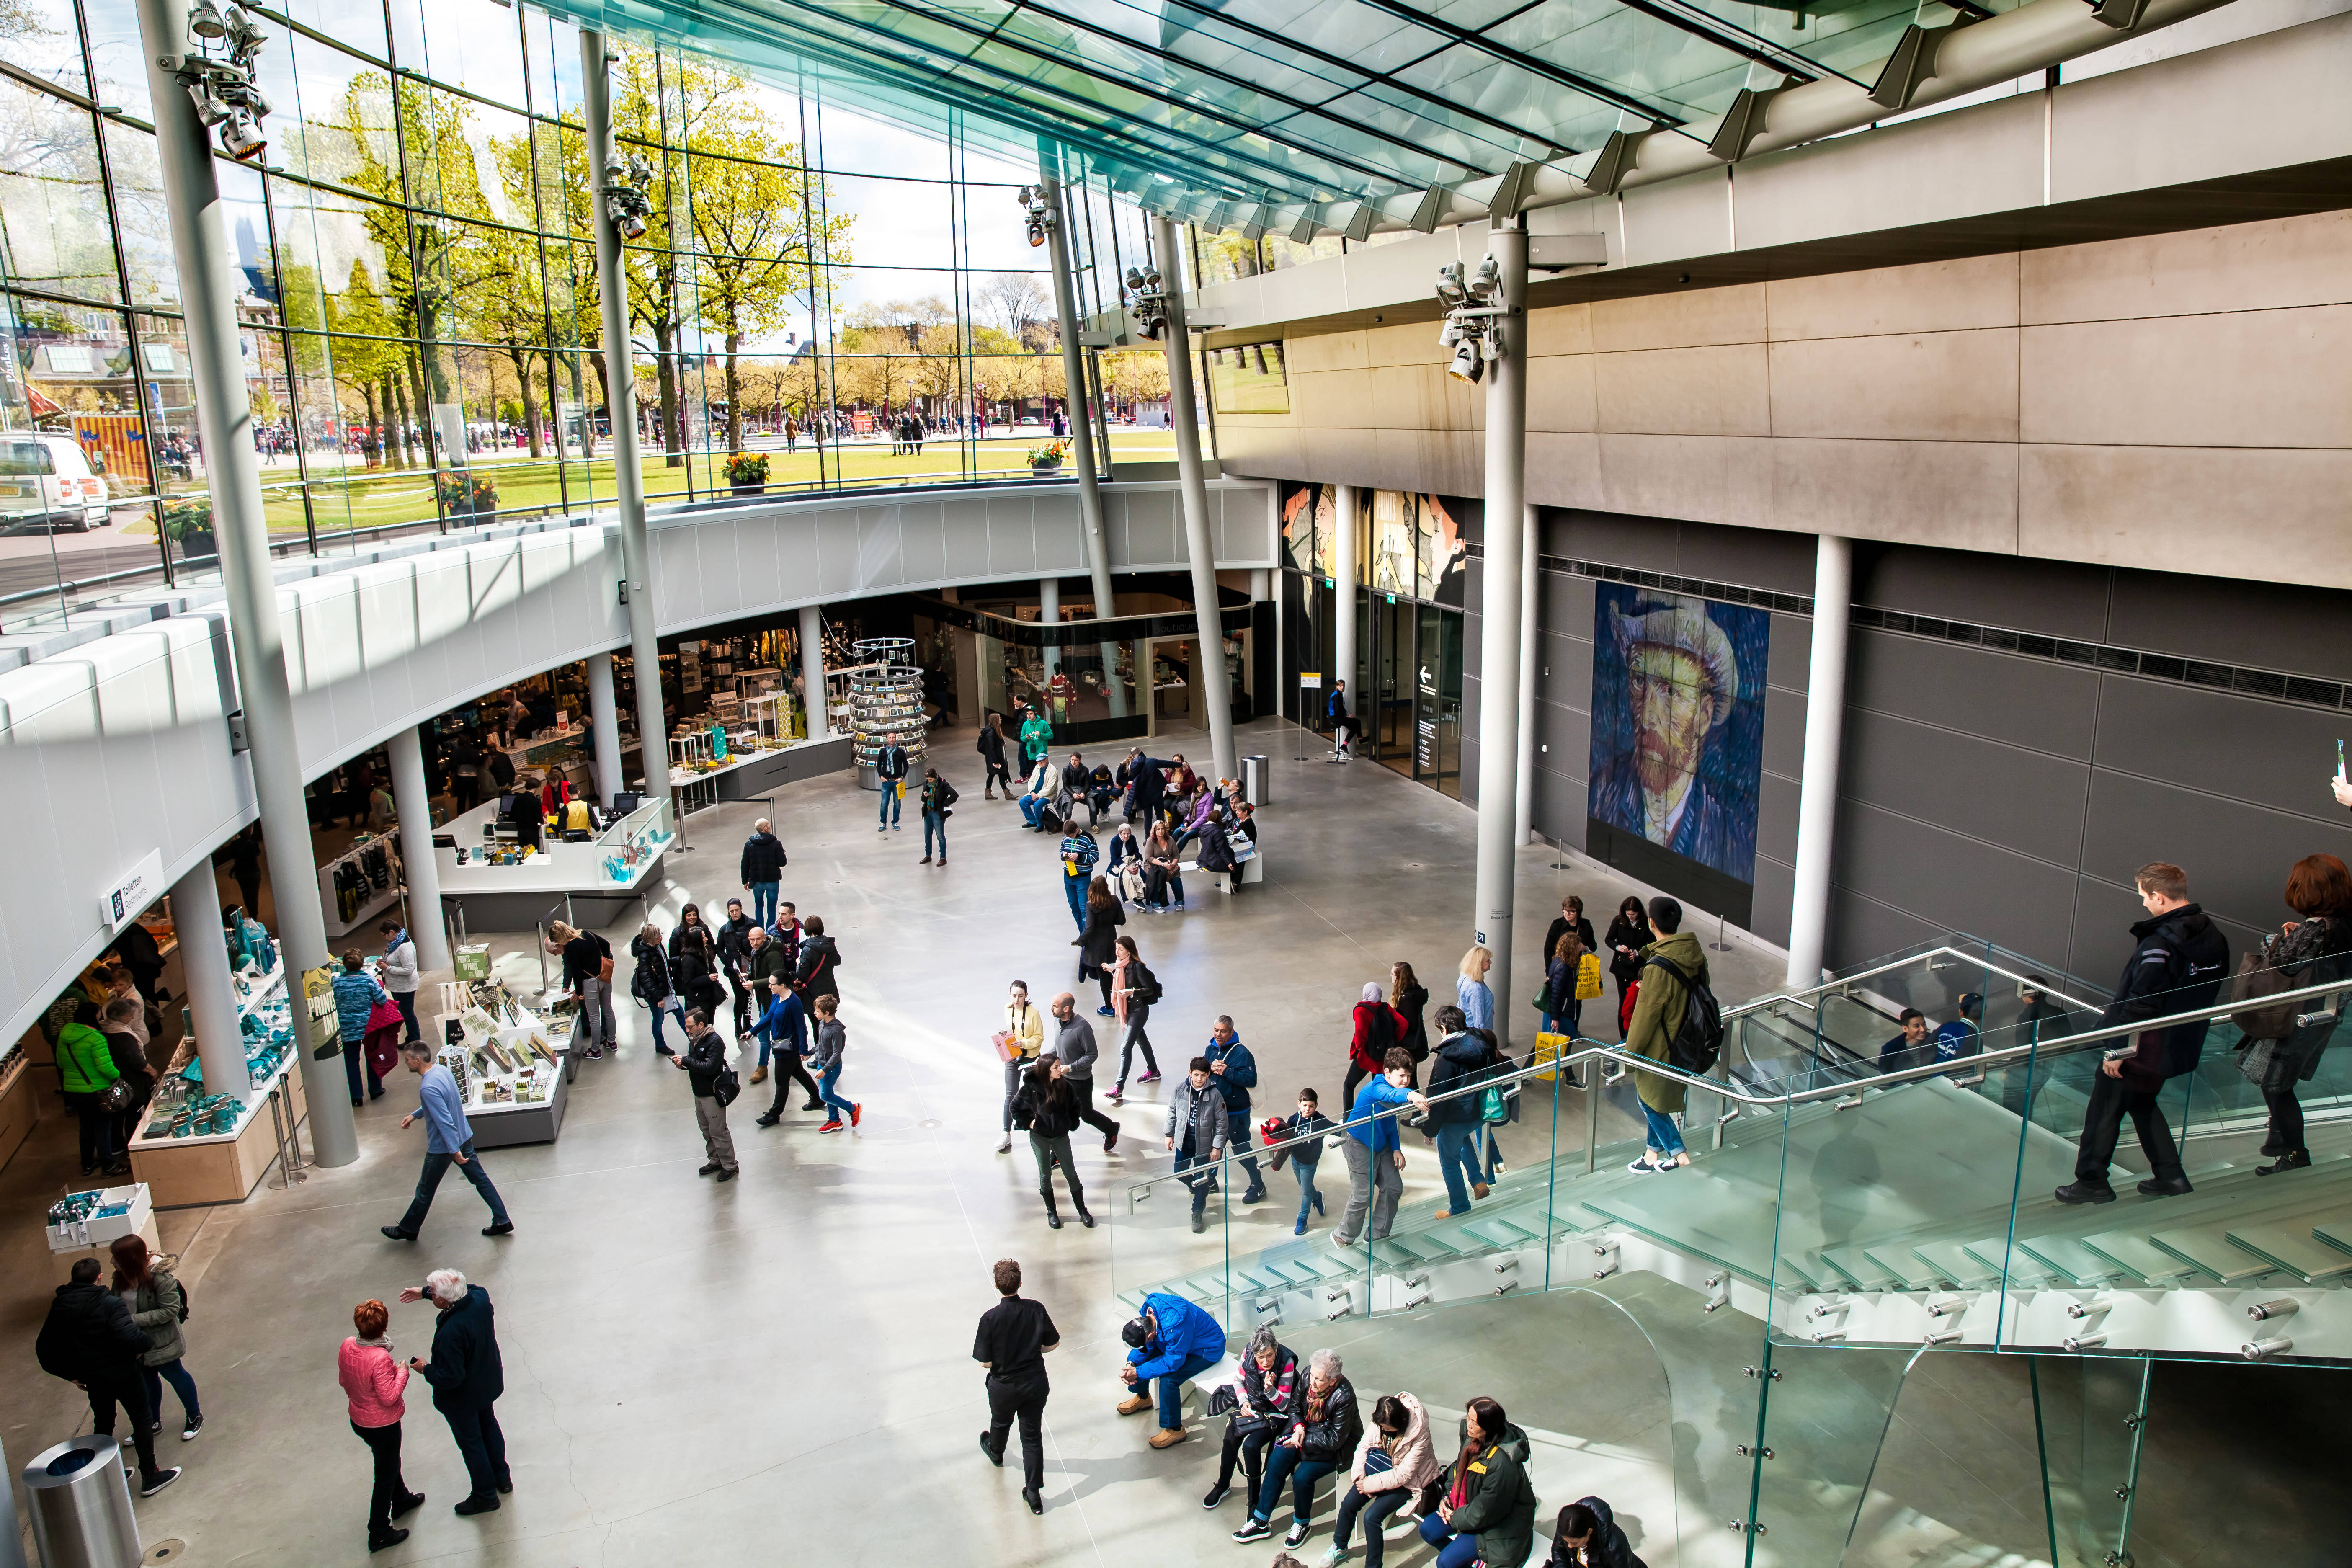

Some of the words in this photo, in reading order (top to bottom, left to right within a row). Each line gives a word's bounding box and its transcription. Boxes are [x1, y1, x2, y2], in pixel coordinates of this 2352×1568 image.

[154, 425, 185, 434] SHOP
[1377, 491, 1396, 521] PRINTS
[1383, 522, 1390, 552] IN
[1390, 524, 1406, 554] PARIS
[1400, 556, 1414, 587] 1900
[1154, 623, 1197, 634] Boutique
[122, 876, 142, 897] Toiletten
[125, 886, 147, 911] Restrooms
[307, 990, 336, 1018] PRINTS
[323, 1014, 334, 1036] IN
[463, 1014, 479, 1028] PRINTS
[472, 1024, 478, 1034] IN
[477, 1019, 489, 1031] PARIS
